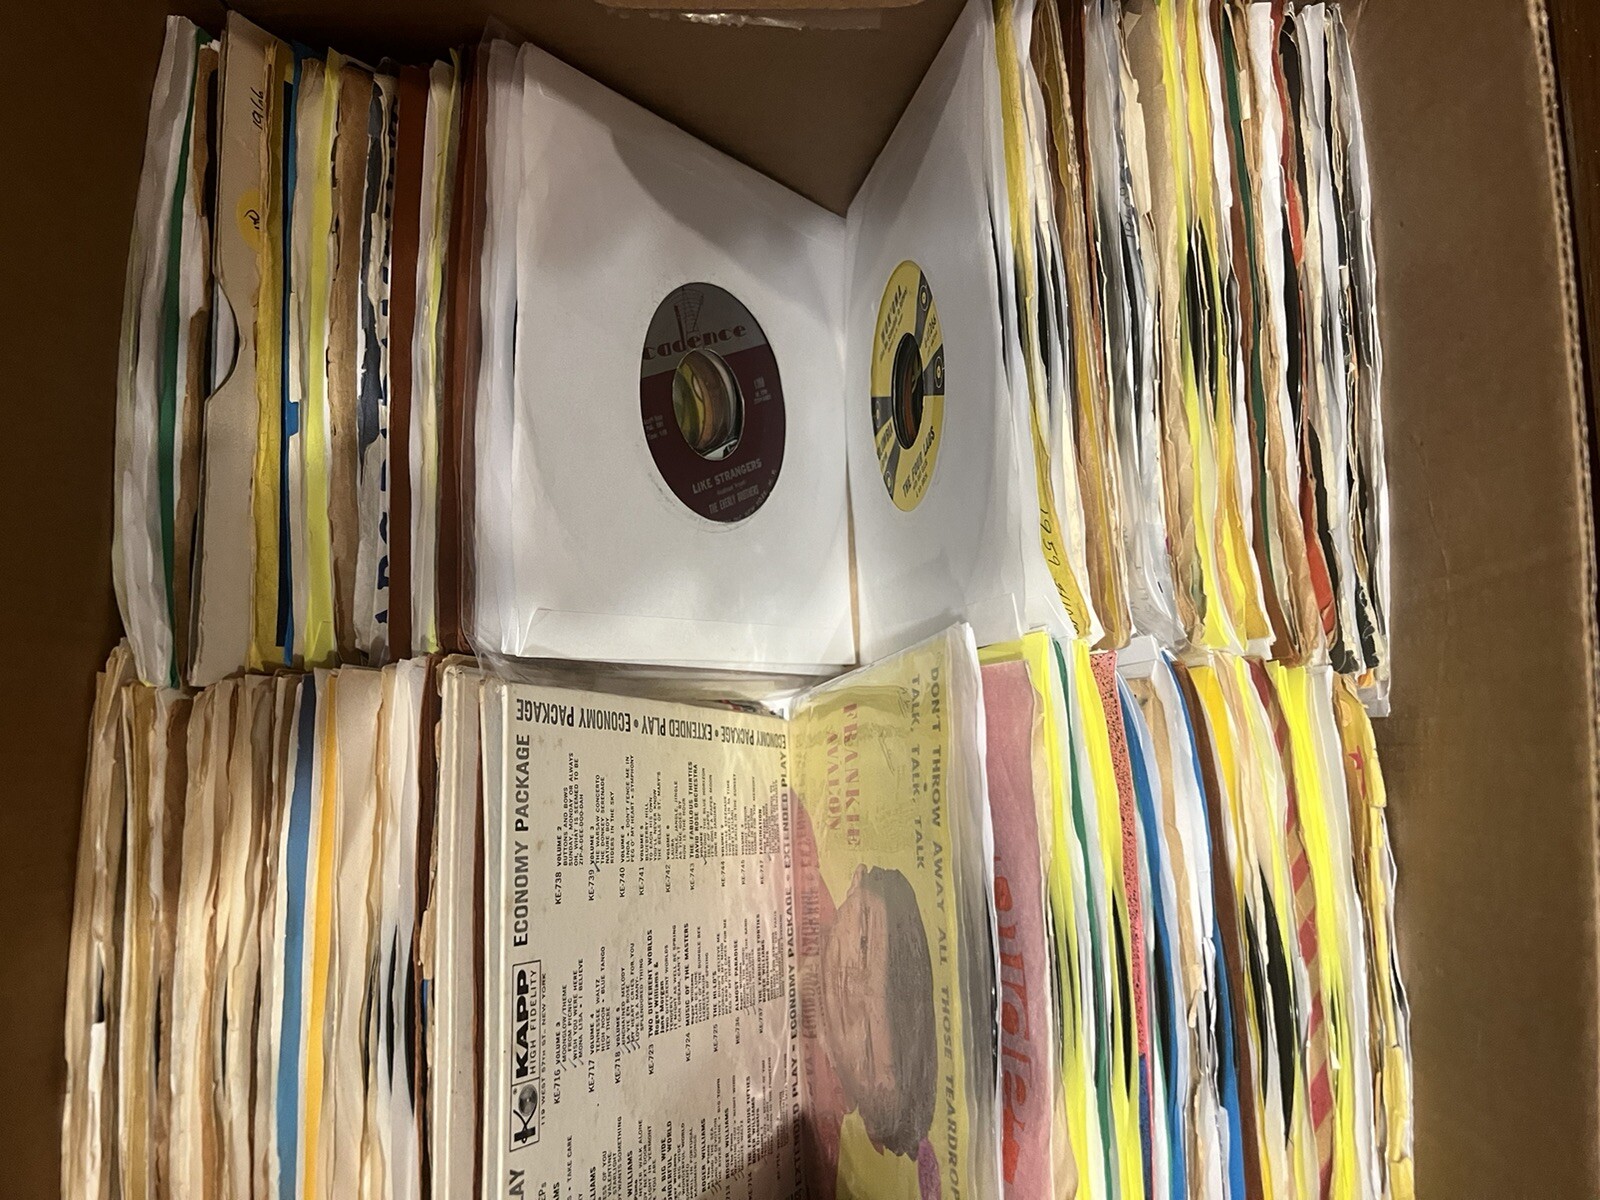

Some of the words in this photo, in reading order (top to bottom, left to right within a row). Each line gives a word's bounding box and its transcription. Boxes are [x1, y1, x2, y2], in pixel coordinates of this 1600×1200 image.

[643, 314, 747, 360] cadence
[692, 479, 712, 494] LIKE
[714, 458, 762, 486] STRANGERS
[902, 478, 911, 497] THE
[912, 451, 923, 477] FOUR
[924, 426, 935, 456] LADS
[709, 502, 718, 514] THE
[516, 699, 574, 727] PACKAGE
[579, 707, 631, 732] ECONOMY
[910, 674, 921, 731] TALK,
[930, 668, 941, 732] DON'T
[641, 716, 666, 736] PLAY
[669, 718, 712, 741] EXTENDED
[721, 726, 754, 745] PACKAGE
[756, 730, 786, 749] ECONOMY
[515, 734, 530, 832] PACKAGE
[574, 758, 579, 768] BE
[574, 771, 579, 781] TO
[826, 731, 841, 831] AVALON
[843, 703, 861, 846] FRANKIE
[911, 744, 921, 802] TALK,
[932, 745, 941, 827] THROW
[569, 785, 574, 795] OR
[914, 816, 925, 869] TALK
[513, 840, 529, 947] ECONOMY
[932, 841, 945, 913] AWAY
[939, 928, 947, 966] ALL
[685, 984, 690, 995] OF
[788, 964, 798, 1039] ECONOMY
[516, 970, 529, 1079] KAPP
[941, 985, 951, 1059] THOSE
[790, 1058, 799, 1098] PLAY
